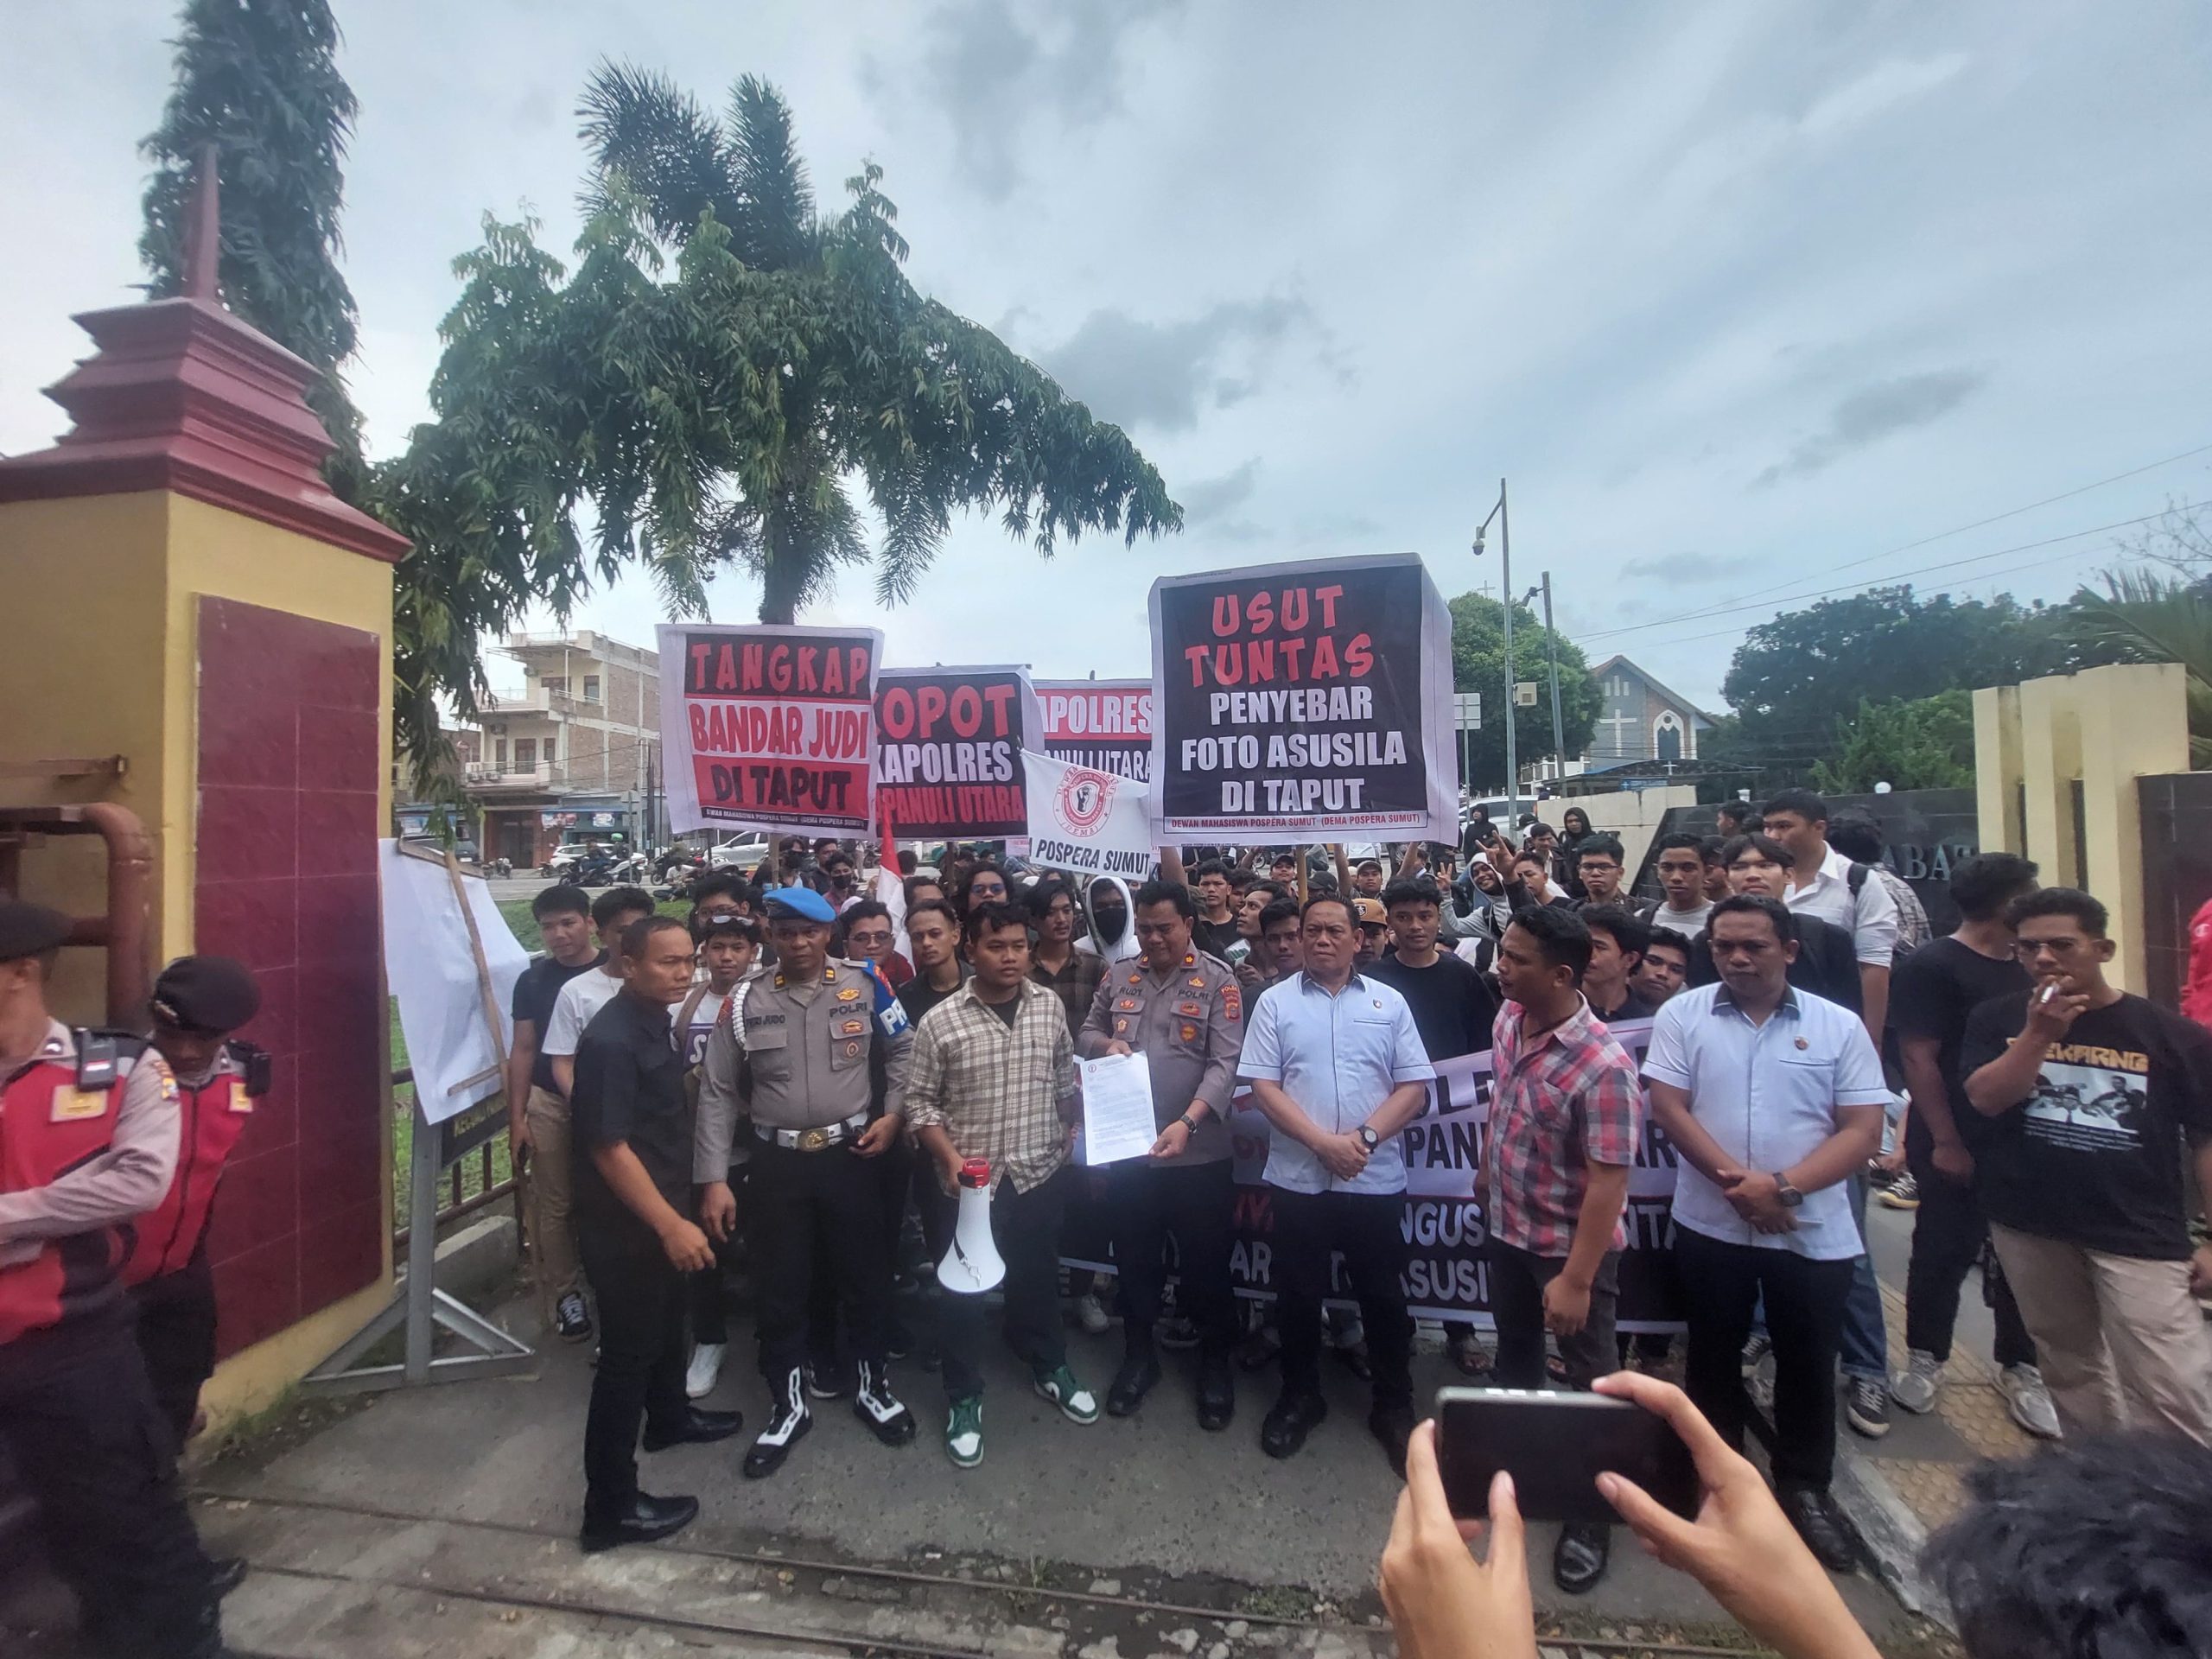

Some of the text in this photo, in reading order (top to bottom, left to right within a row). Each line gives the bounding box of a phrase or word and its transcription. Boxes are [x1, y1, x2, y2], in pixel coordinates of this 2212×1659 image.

[1212, 584, 1344, 637] USUT
[691, 643, 868, 694] TANGKAP
[1185, 633, 1374, 688] TUNTAS
[874, 684, 1015, 739] OPOT
[1211, 686, 1372, 726] PENYEBAR
[689, 703, 868, 760] BANDAR JUDI
[1182, 731, 1408, 772] FOTO ASUSILA
[710, 765, 851, 810] DI TAPUT
[957, 785, 1026, 822] UTARA
[1222, 779, 1364, 812] DI TAPUT
[1172, 813, 1421, 829] DEWAN MAHASISWA POSPERA SUMUT (DEMA POSPERA SUMUT)
[1036, 839, 1100, 868] POSPERA
[1103, 849, 1150, 874] SUMUT
[830, 1002, 868, 1018] POLRI
[1120, 987, 1142, 996] RUDY
[1399, 1259, 1491, 1303] SUSI
